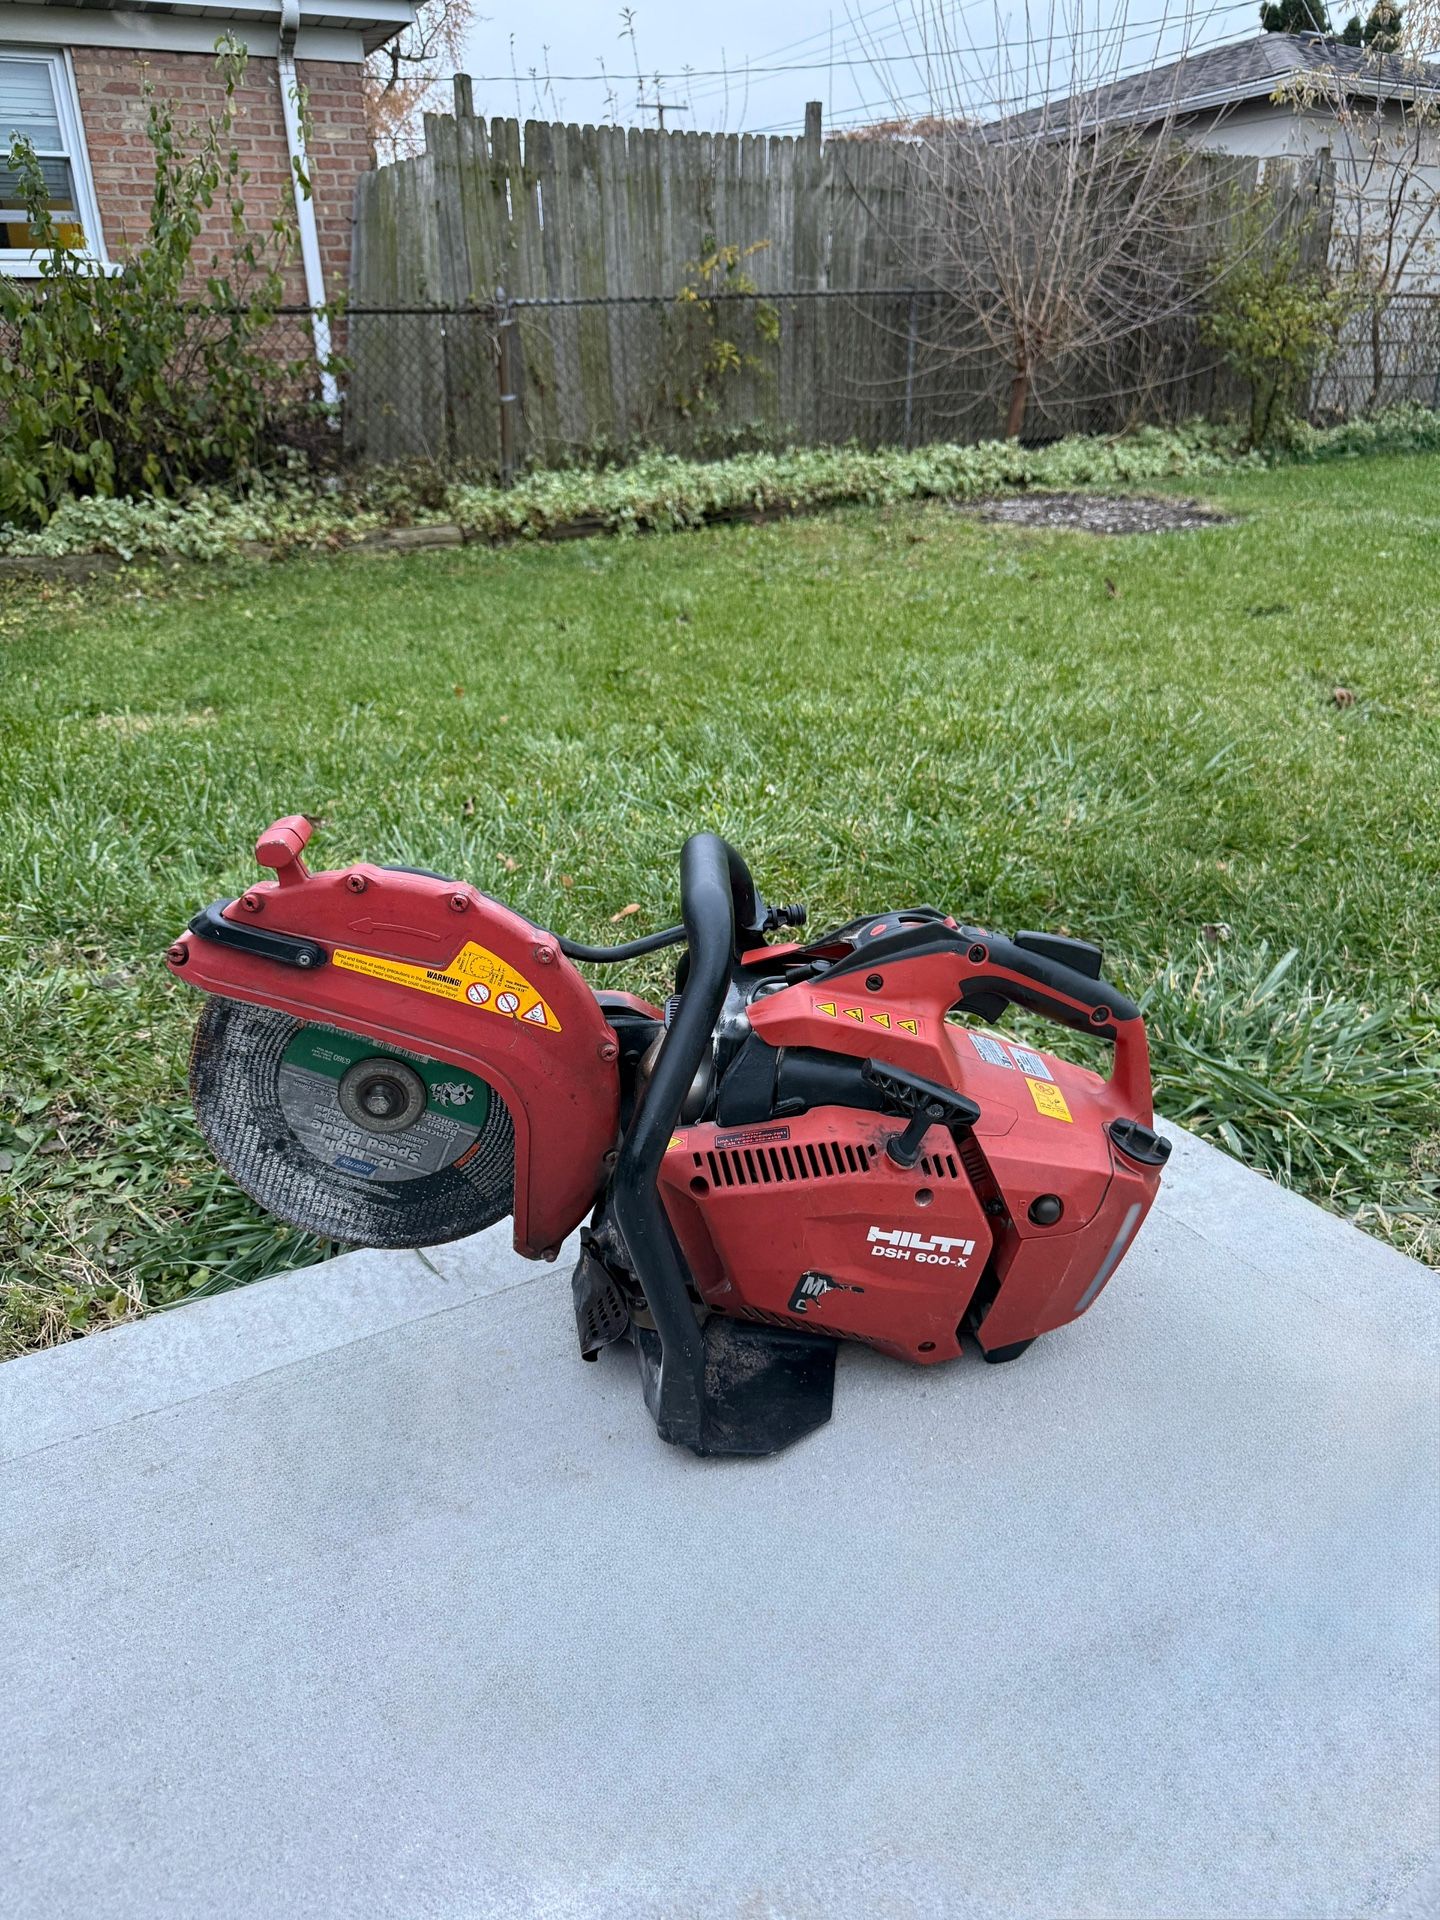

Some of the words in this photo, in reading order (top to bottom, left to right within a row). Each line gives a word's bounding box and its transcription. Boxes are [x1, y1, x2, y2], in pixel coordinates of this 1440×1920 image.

[426, 970, 462, 987] WARNING!
[332, 1054, 351, 1065] 6360
[421, 1112, 460, 1130] Concret
[311, 1119, 363, 1145] Blade
[324, 1138, 366, 1161] High
[366, 1137, 421, 1164] Speed
[340, 1157, 372, 1172] NORTON
[370, 1156, 397, 1170] 12"
[866, 1225, 976, 1256] HILTI
[871, 1245, 911, 1261] DSH
[914, 1252, 969, 1268] 600-X
